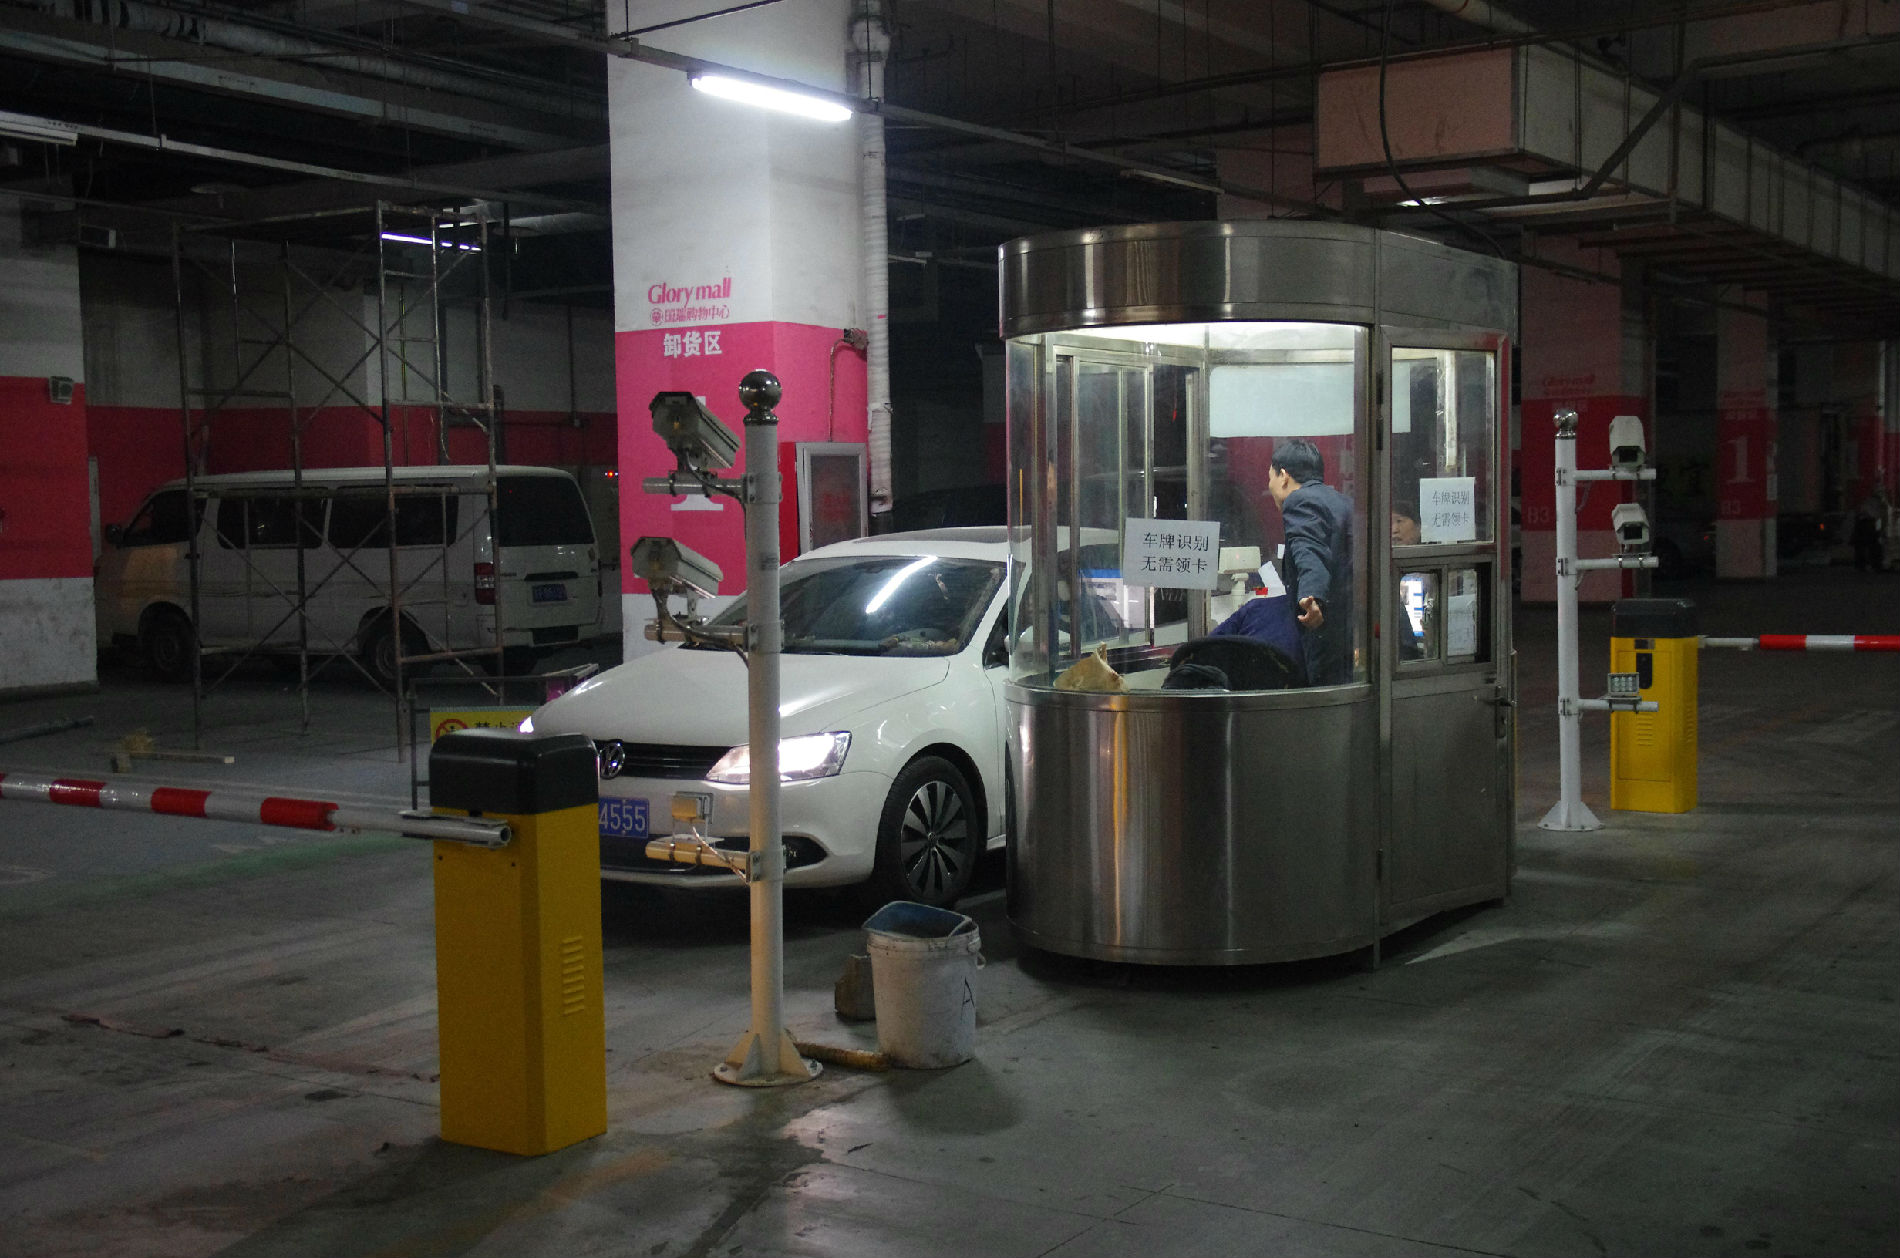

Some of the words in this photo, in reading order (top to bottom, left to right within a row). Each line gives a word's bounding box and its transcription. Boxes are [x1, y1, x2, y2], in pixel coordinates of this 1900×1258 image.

[647, 281, 695, 309] Glory
[696, 276, 732, 300] mall
[663, 331, 722, 358] 卸货区
[1432, 490, 1470, 506] 车牌识别
[1431, 512, 1470, 528] 无需领卡
[1527, 506, 1550, 524] B3
[1142, 532, 1209, 552] 车牌识别
[1140, 555, 1208, 574] 无需领卡
